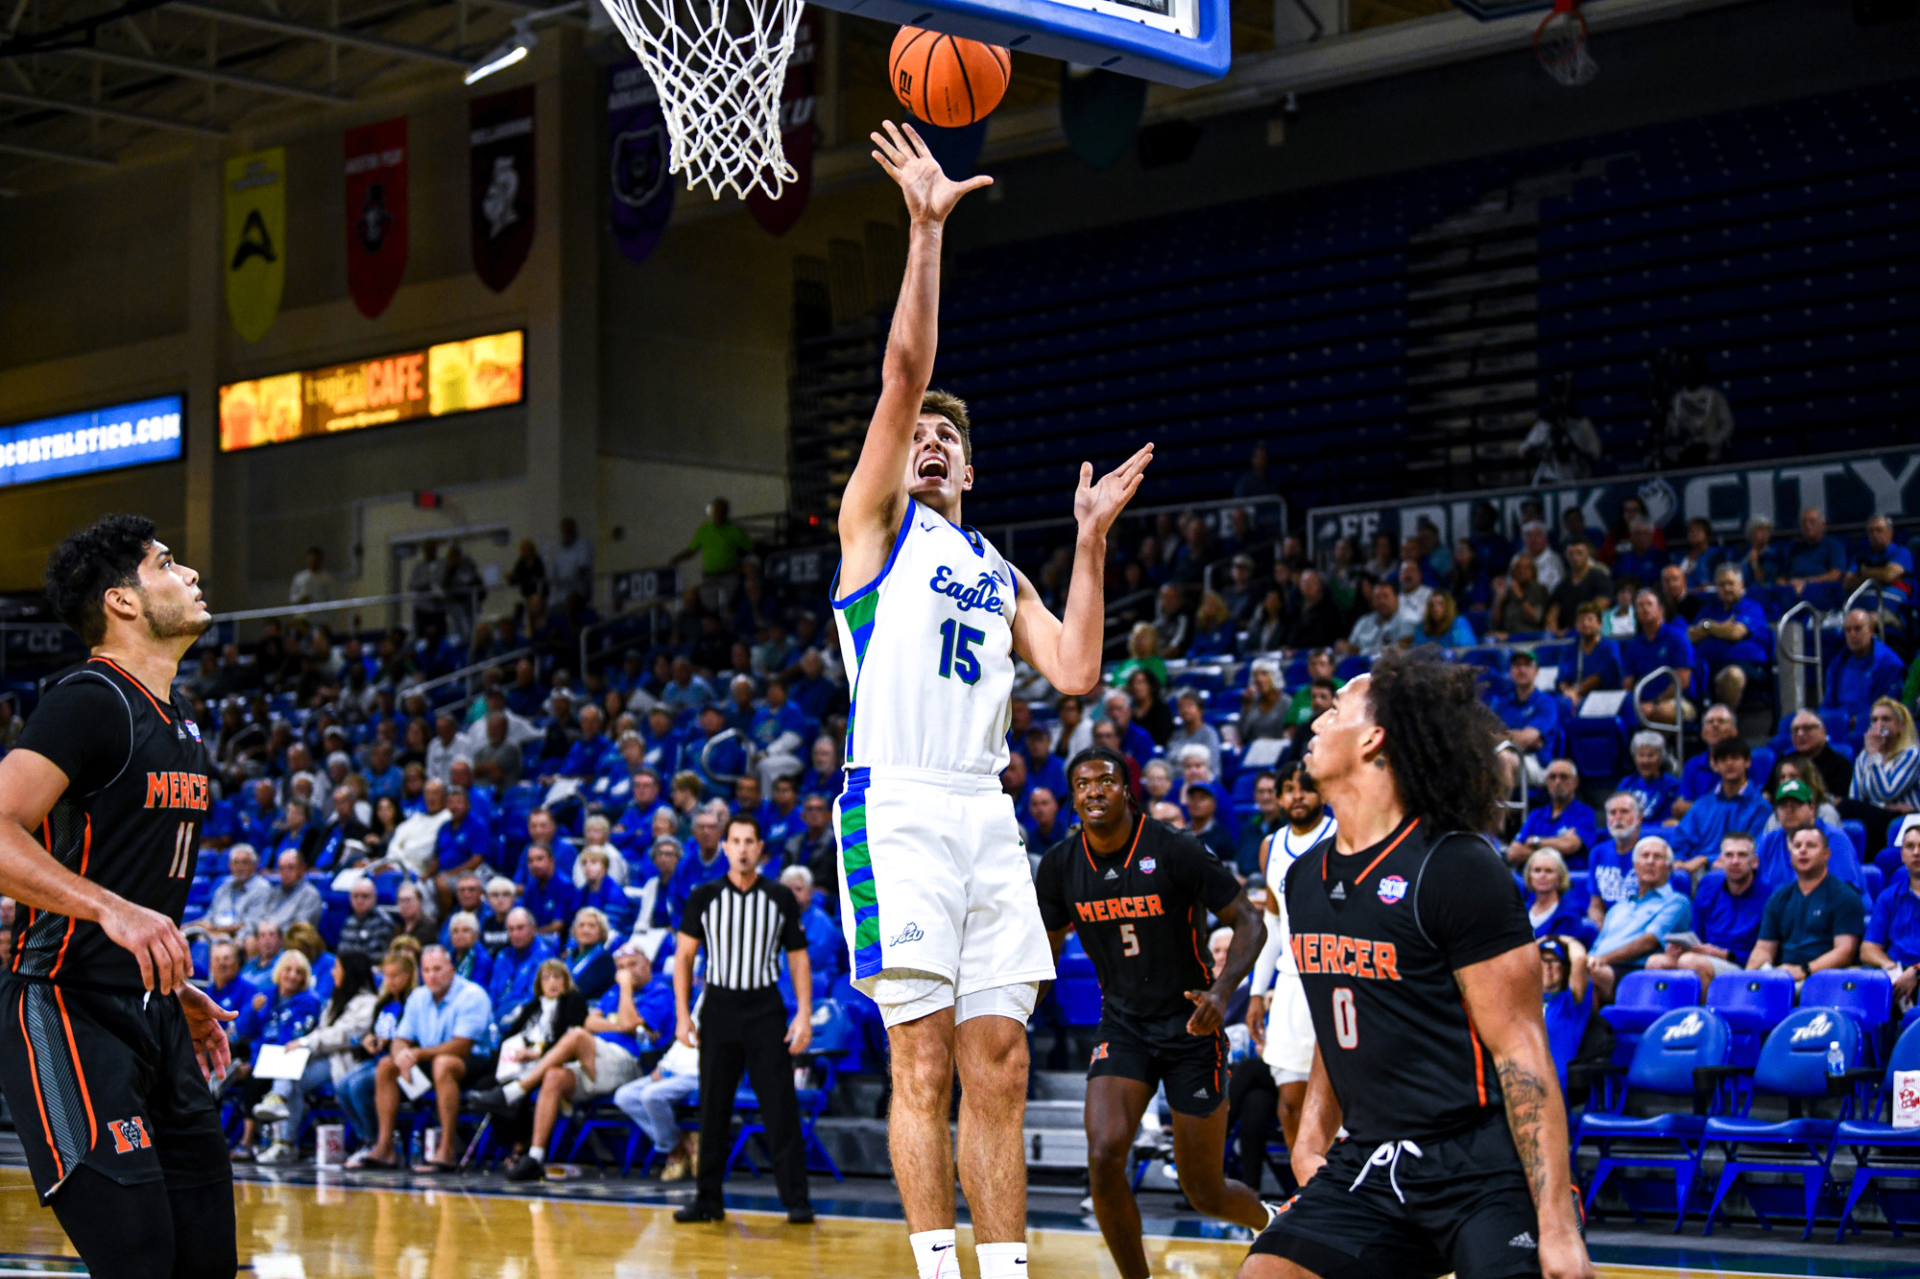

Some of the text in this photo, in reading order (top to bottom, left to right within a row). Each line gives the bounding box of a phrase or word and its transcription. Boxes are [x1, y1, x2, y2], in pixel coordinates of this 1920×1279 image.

[366, 353, 425, 408] CAFE
[1684, 453, 1920, 532] CITY
[27, 629, 64, 654] CC
[939, 617, 986, 686] 15
[143, 771, 209, 811] MERCE
[168, 821, 195, 879] 11
[1075, 894, 1165, 922] MERCER
[1119, 923, 1140, 958] 5
[1290, 932, 1402, 981] MERCER
[1332, 986, 1359, 1050] 0
